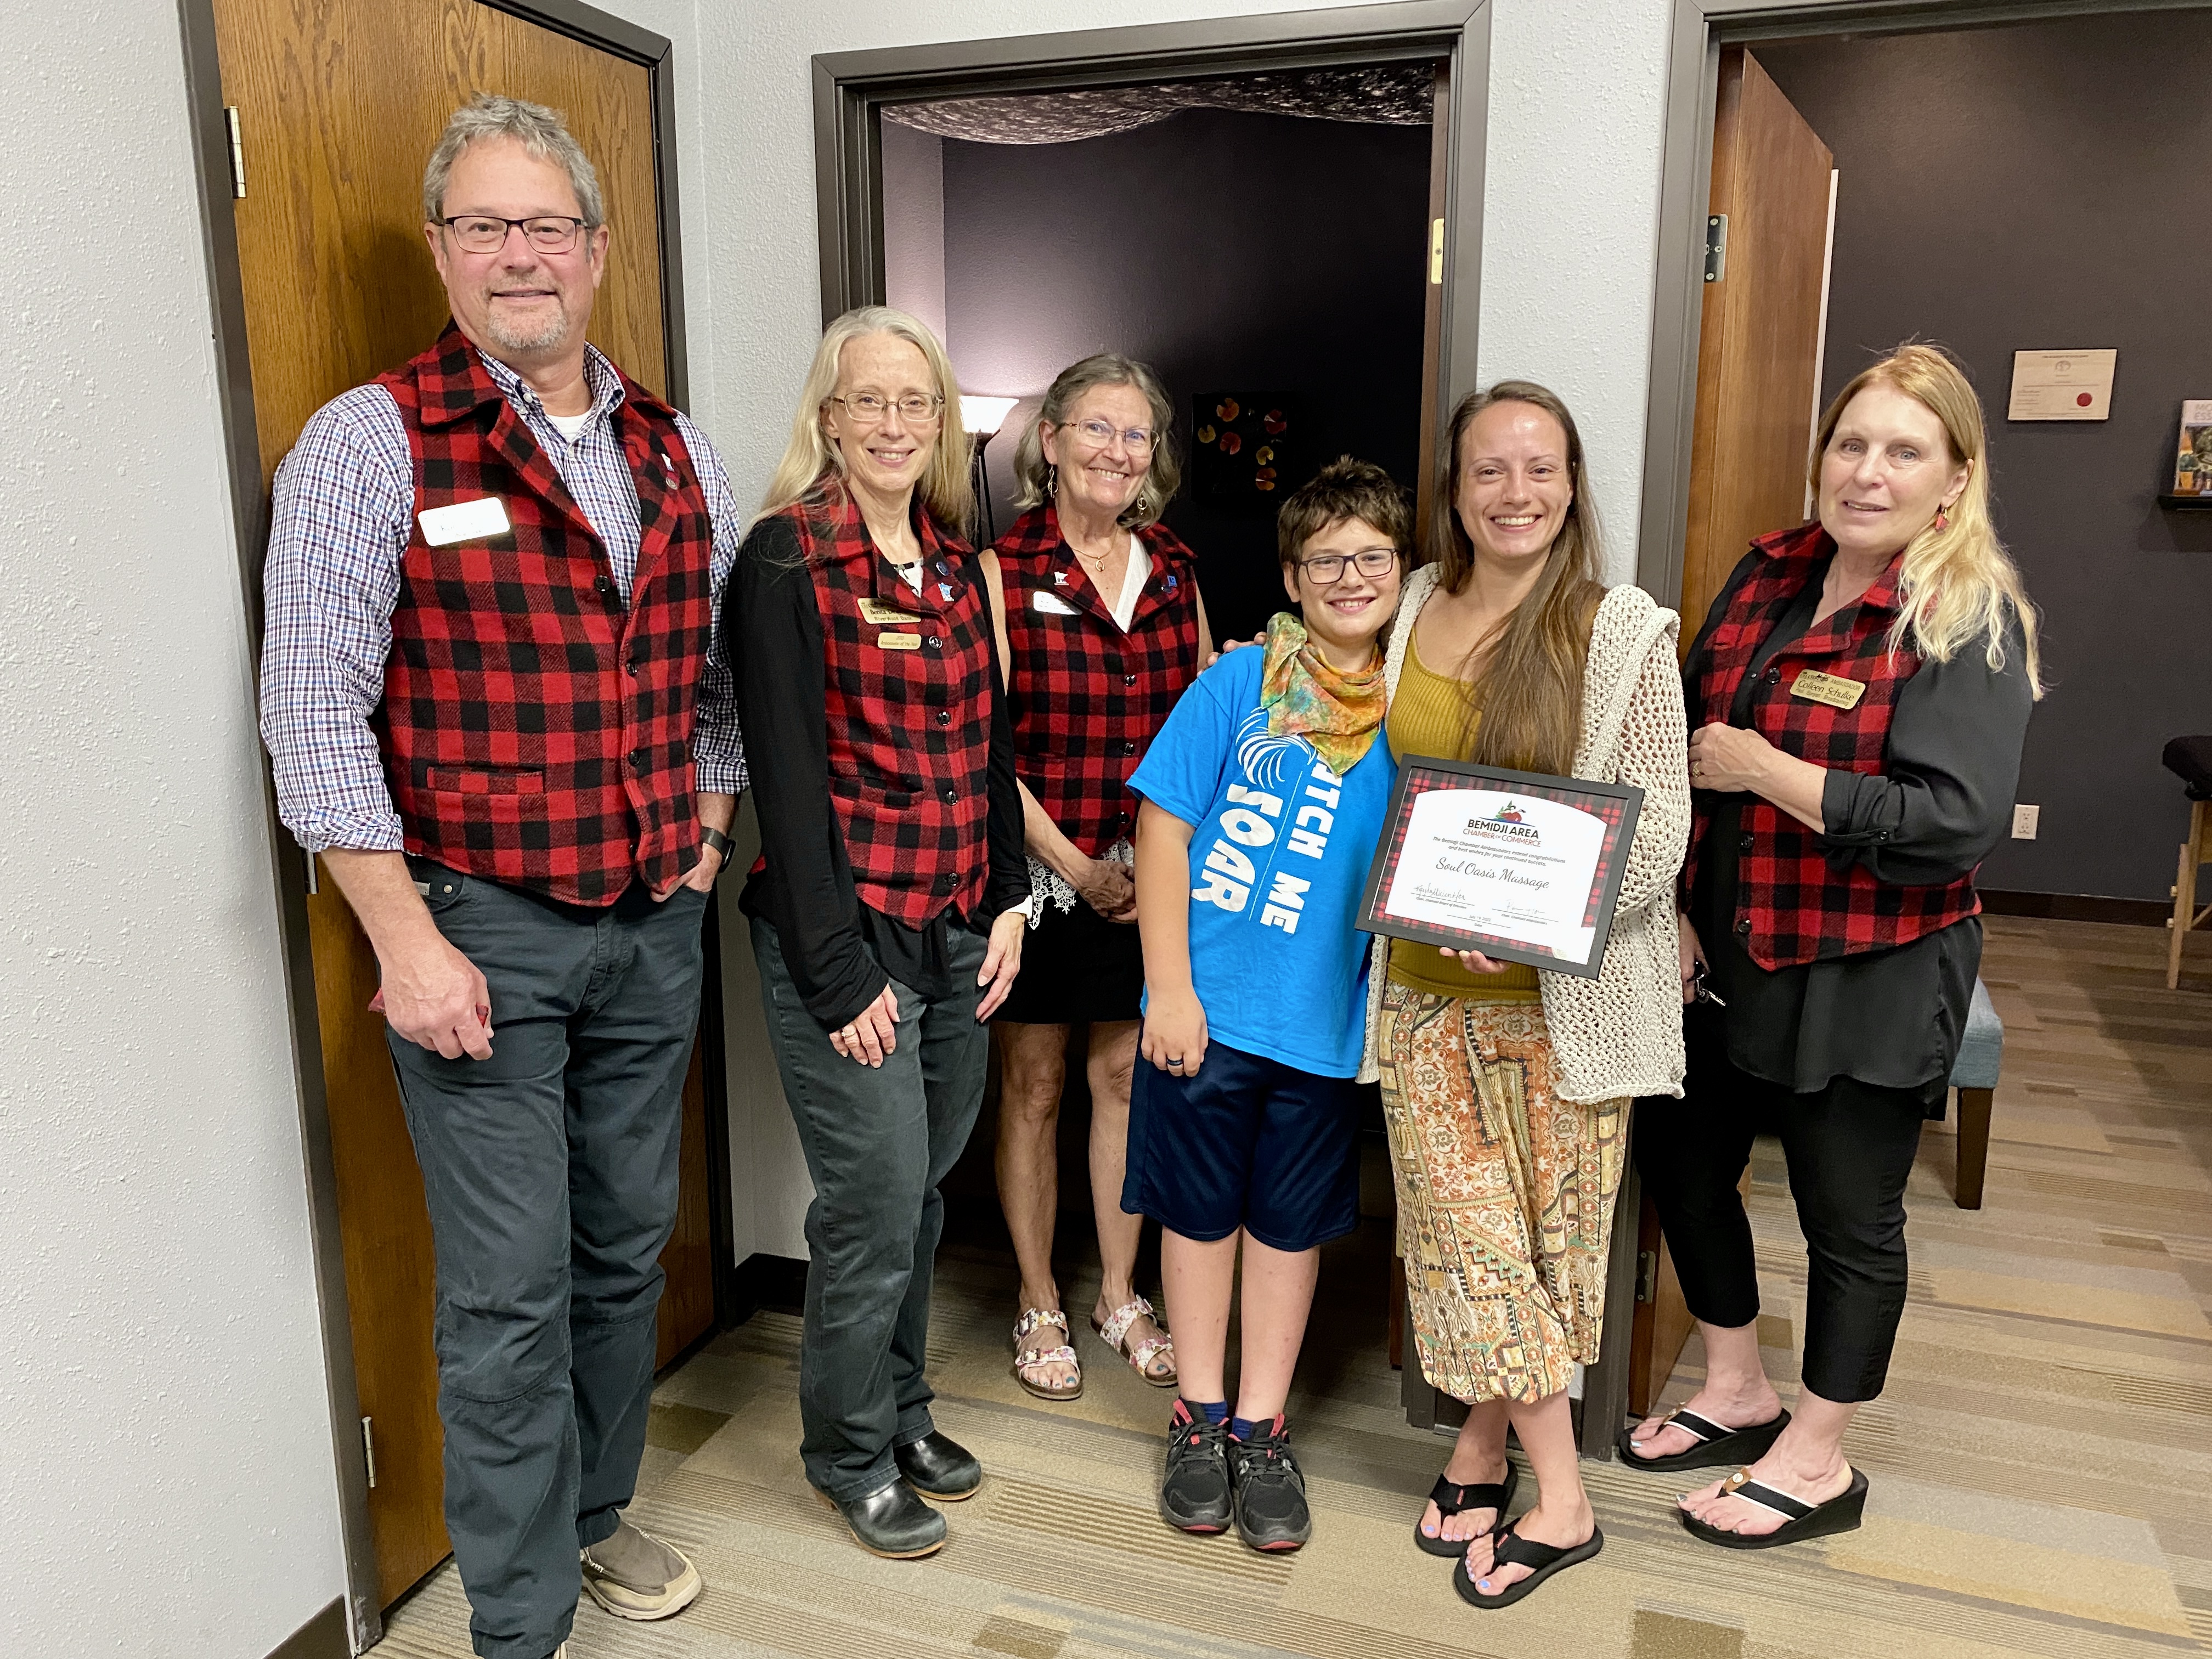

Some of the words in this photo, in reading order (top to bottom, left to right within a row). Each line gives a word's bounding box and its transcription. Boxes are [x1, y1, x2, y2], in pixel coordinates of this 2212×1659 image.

[1798, 680, 1825, 693] Colleen
[1825, 687, 1854, 701] Schulke
[1830, 679, 1861, 691] AMBASSADOR
[1463, 828, 1496, 839] CHAMBER
[1502, 834, 1542, 847] COMMERCE
[1468, 819, 1509, 834] BEMIDJI
[1509, 826, 1539, 839] AREA
[1191, 783, 1284, 912] SOAR
[1441, 838, 1459, 846] Bemidji
[1480, 845, 1511, 854] Ambassadors
[1528, 853, 1566, 864] congratulations
[1504, 855, 1527, 863] continued
[1436, 857, 1465, 873] Soul
[1464, 862, 1497, 879] Oasis
[1499, 868, 1550, 891] Massage
[1260, 871, 1311, 934] ME
